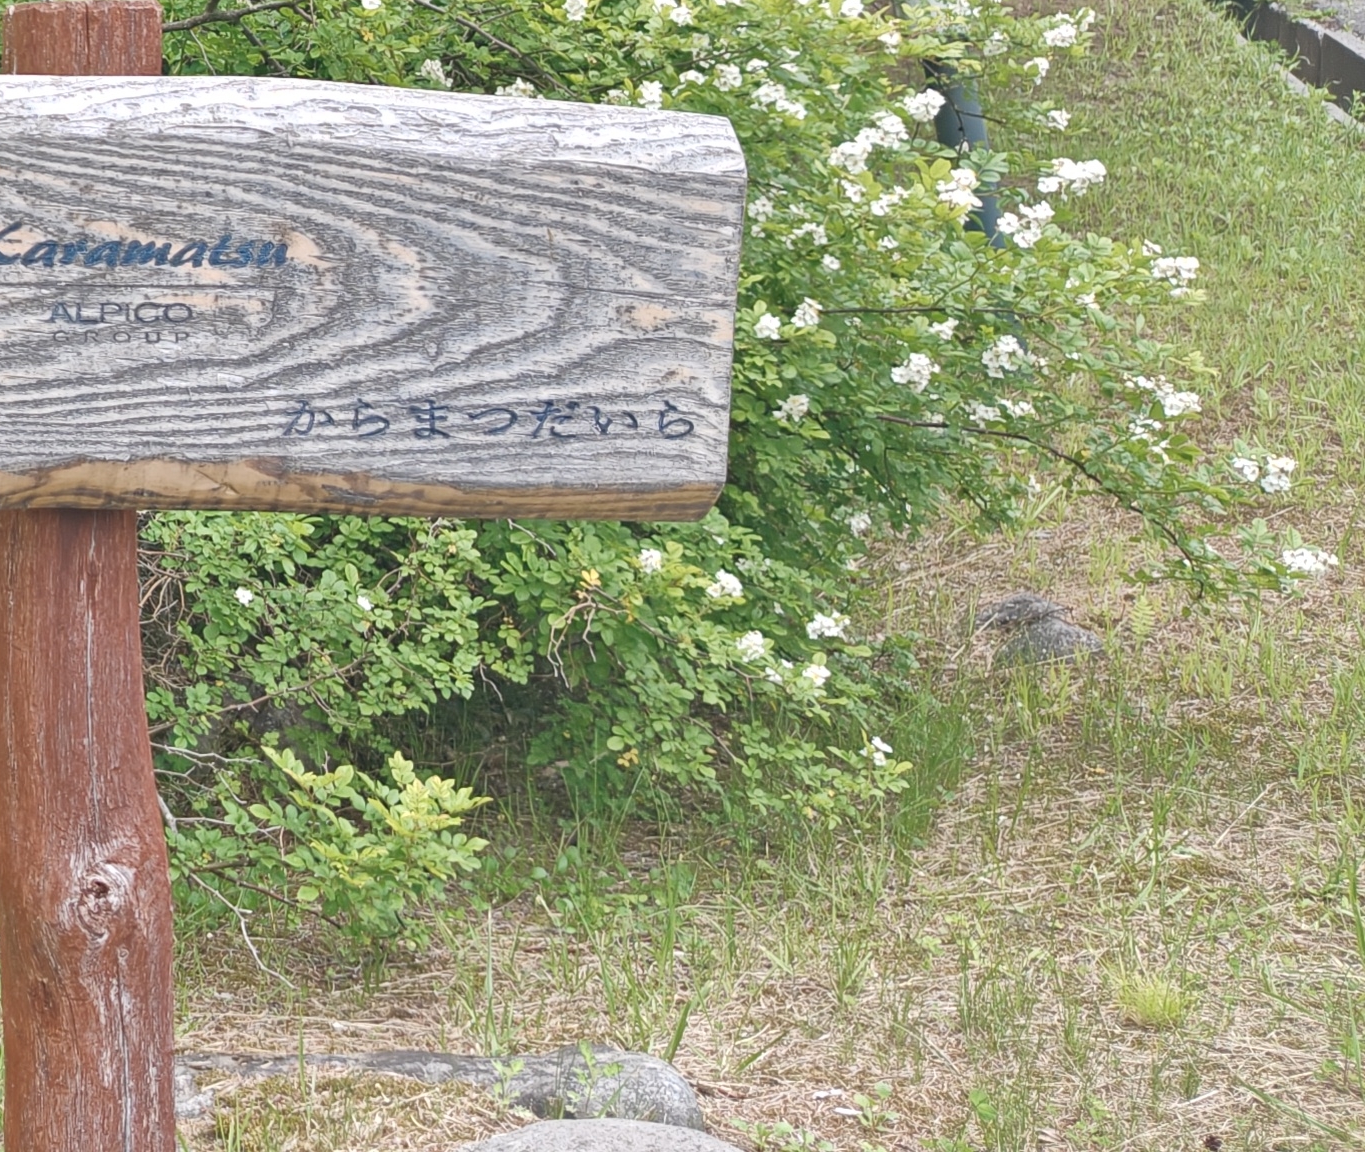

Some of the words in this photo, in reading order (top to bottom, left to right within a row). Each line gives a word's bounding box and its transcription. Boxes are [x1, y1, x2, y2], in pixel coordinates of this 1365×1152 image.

[49, 302, 194, 324] ALPICO
[52, 330, 190, 344] GROUP
[281, 398, 695, 439] からまつだいら
